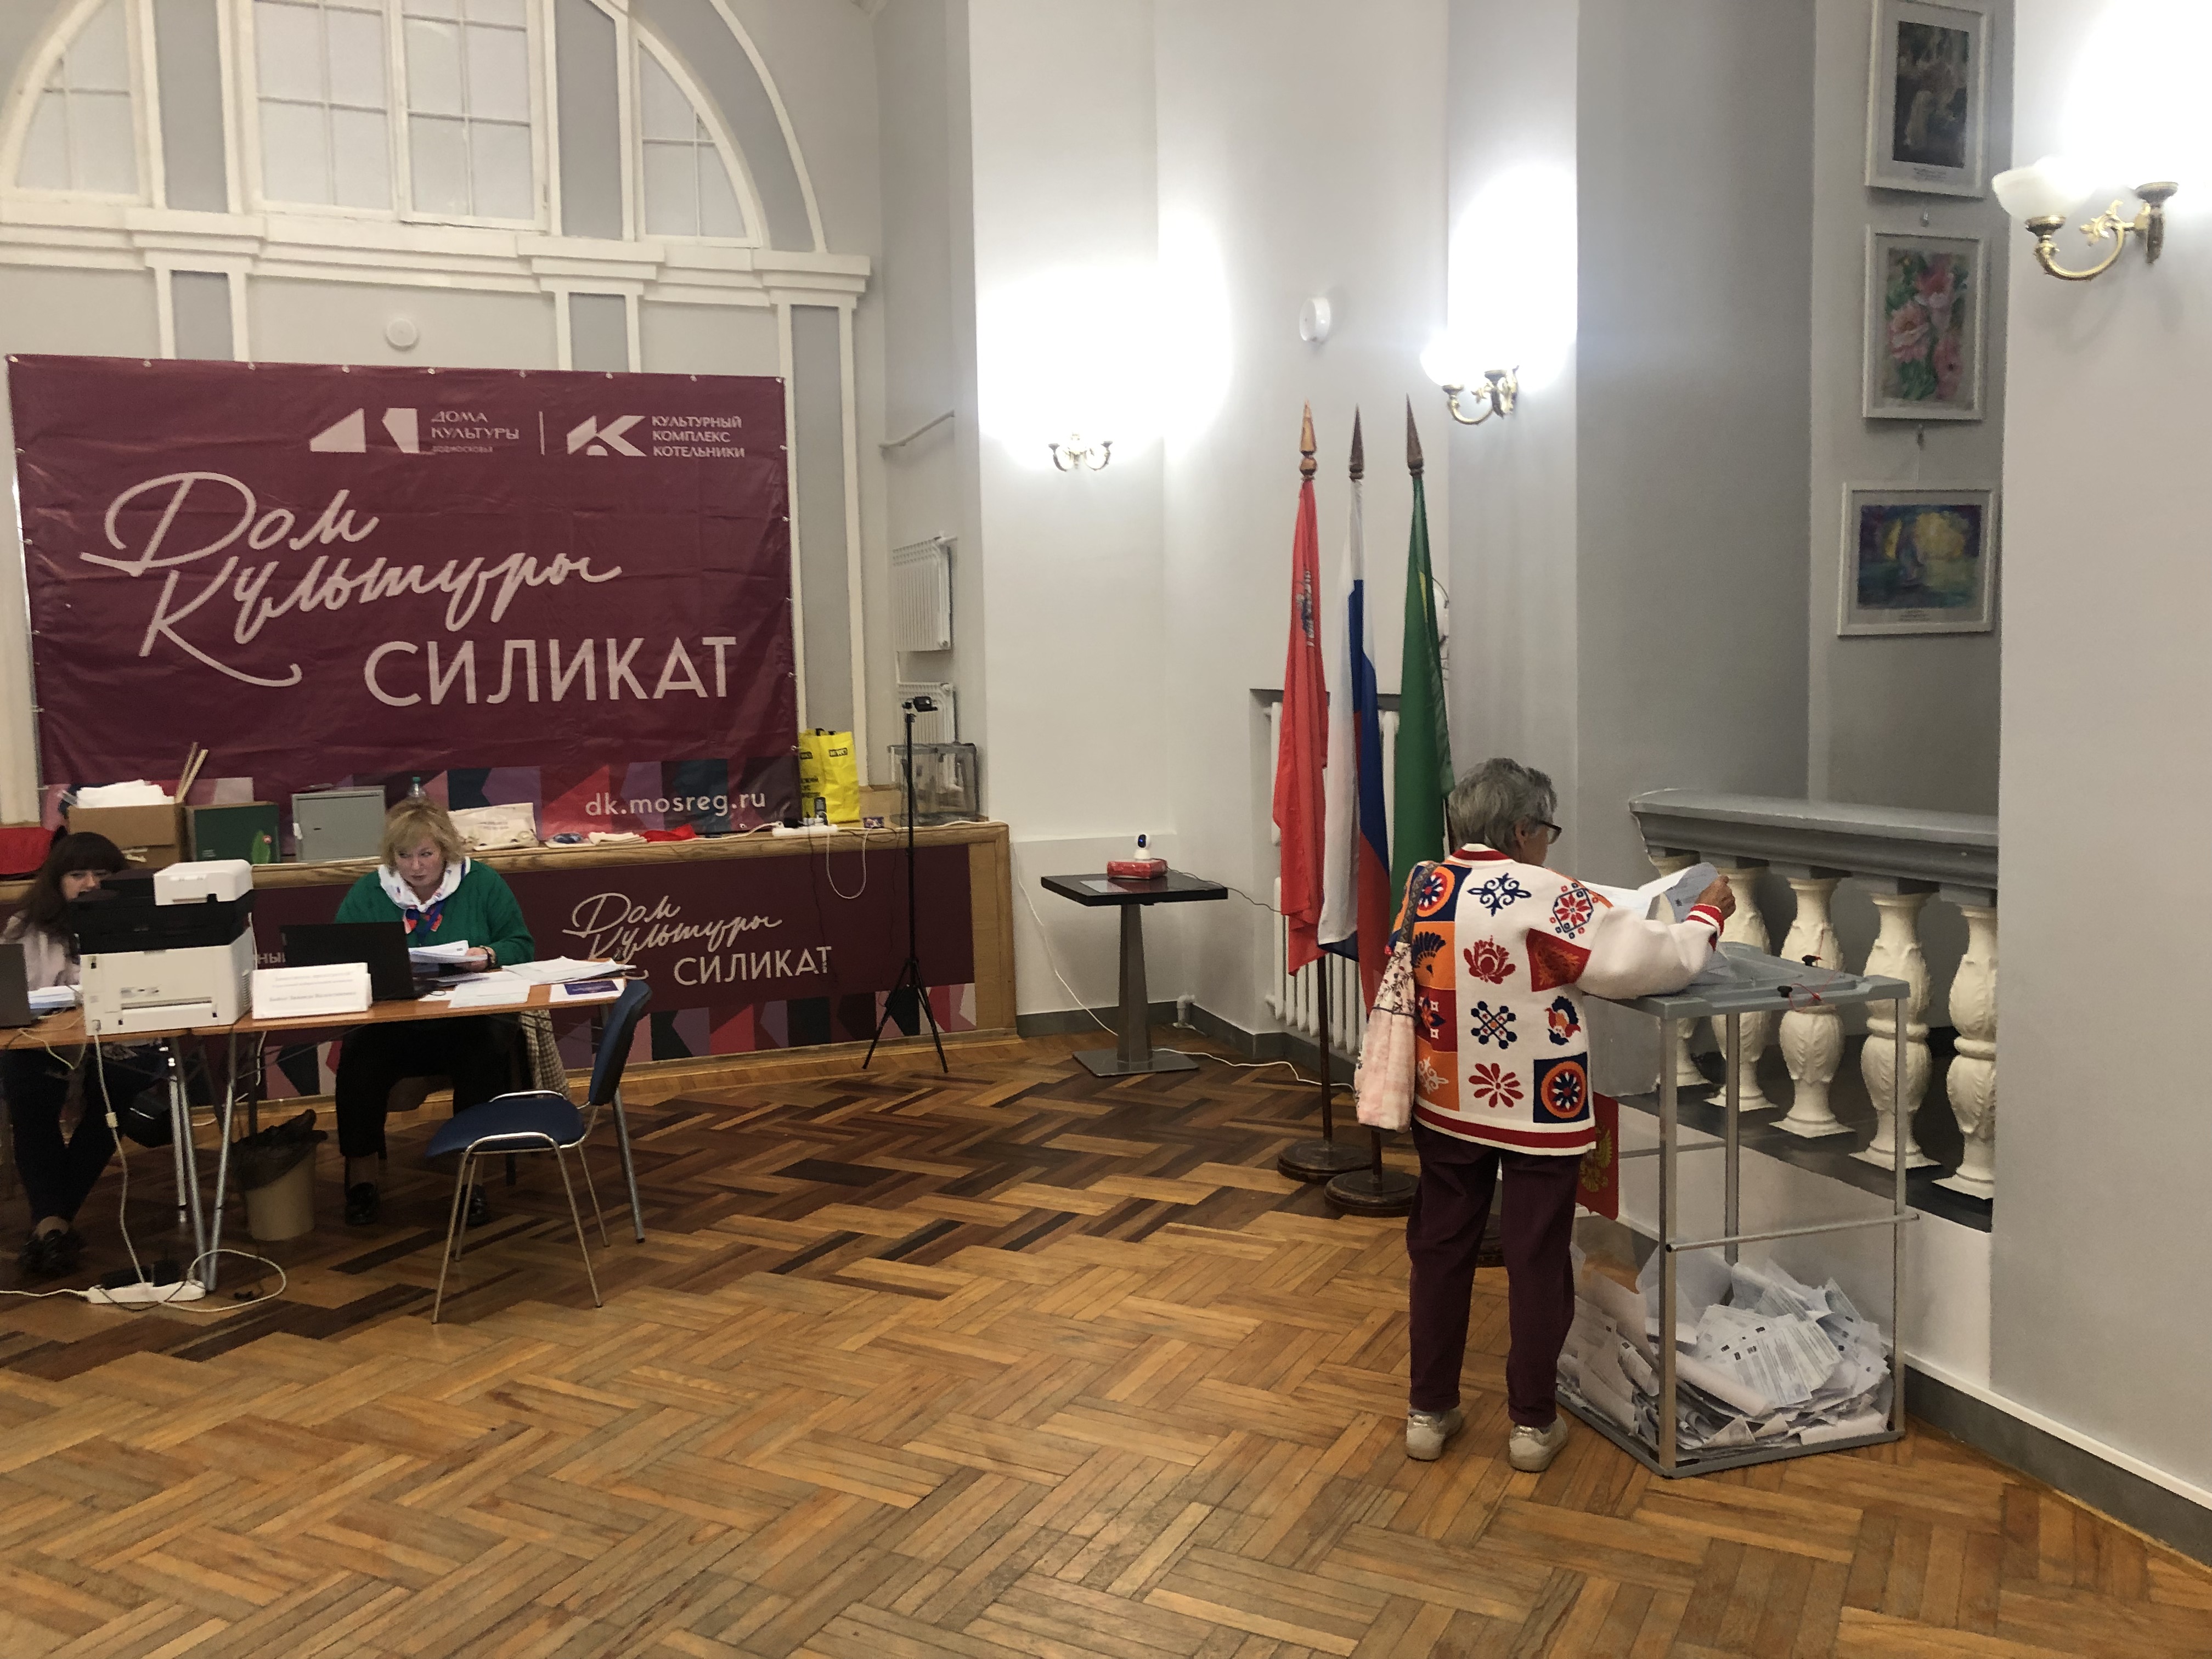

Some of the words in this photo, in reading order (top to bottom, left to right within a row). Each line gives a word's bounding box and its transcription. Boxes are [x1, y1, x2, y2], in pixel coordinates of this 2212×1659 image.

[431, 410, 488, 423] ДОМА
[651, 415, 742, 428] КУЛЬТУРНЫЙ
[431, 427, 520, 439] КУЛЬТУРЫ
[652, 430, 731, 443] КОМПЛЕКС
[653, 445, 746, 458] КОТЕЛЬНИКИ
[79, 471, 380, 576] Дом
[137, 550, 622, 688] Культуры
[362, 635, 738, 708] СИЛИКАТ
[585, 792, 766, 817] dk.mosreg.ru
[562, 892, 681, 938] Дом
[673, 946, 832, 986] СИЛИКАТ
